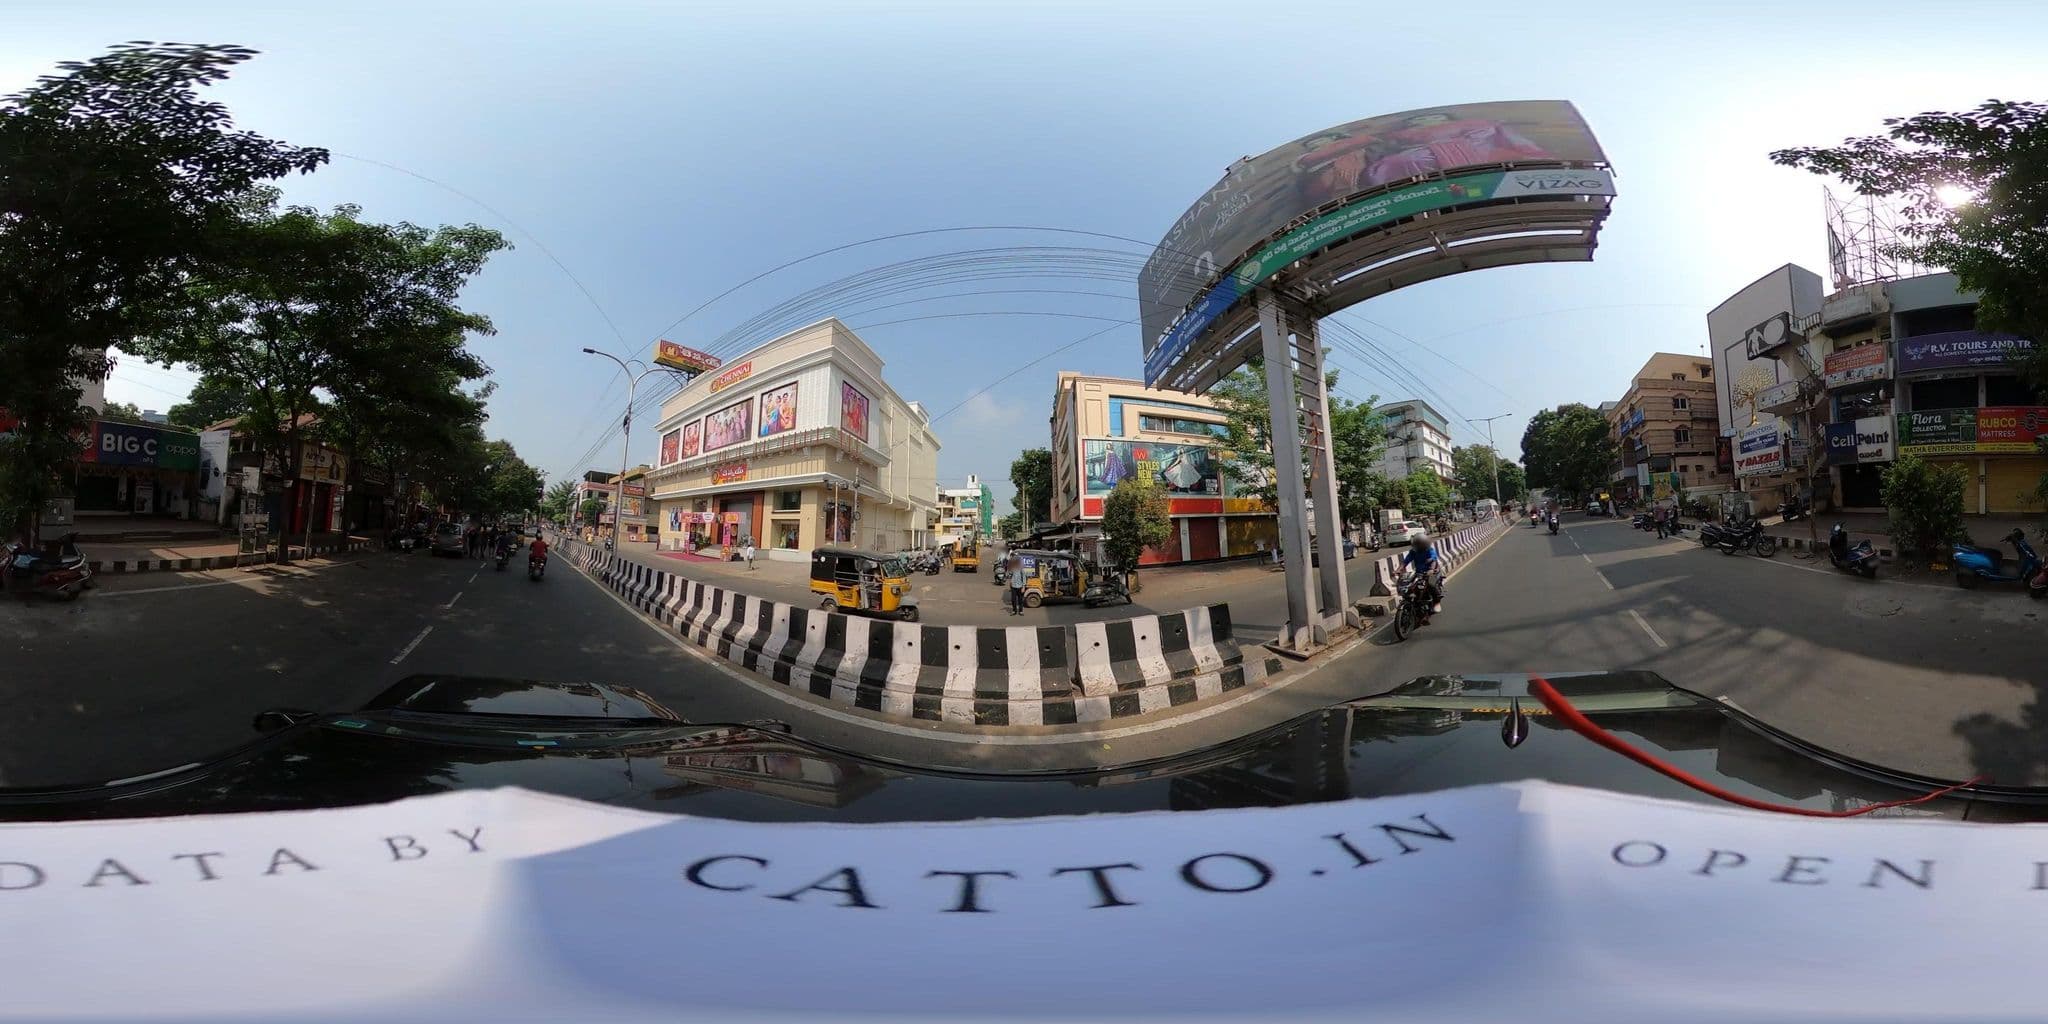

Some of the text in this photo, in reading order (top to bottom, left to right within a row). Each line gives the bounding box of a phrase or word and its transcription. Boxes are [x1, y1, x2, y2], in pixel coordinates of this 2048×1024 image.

[1518, 179, 1602, 190] VIZAG
[1952, 340, 1987, 351] TOURS
[1990, 339, 2015, 349] AND
[1912, 414, 1942, 425] Flora
[1980, 417, 2017, 429] RUBCO
[1912, 424, 1946, 433] COLLECTION
[1980, 430, 2016, 438] MATTRESS
[102, 433, 140, 454] BIG
[143, 438, 158, 455] C
[1832, 431, 1889, 447] Cell Point
[1928, 444, 1976, 452] ENTERPRISES
[1137, 460, 1160, 471] STYLES
[384, 826, 486, 861] BY
[684, 813, 1456, 911] CATTO.IN
[1612, 839, 1936, 891] OPEN
